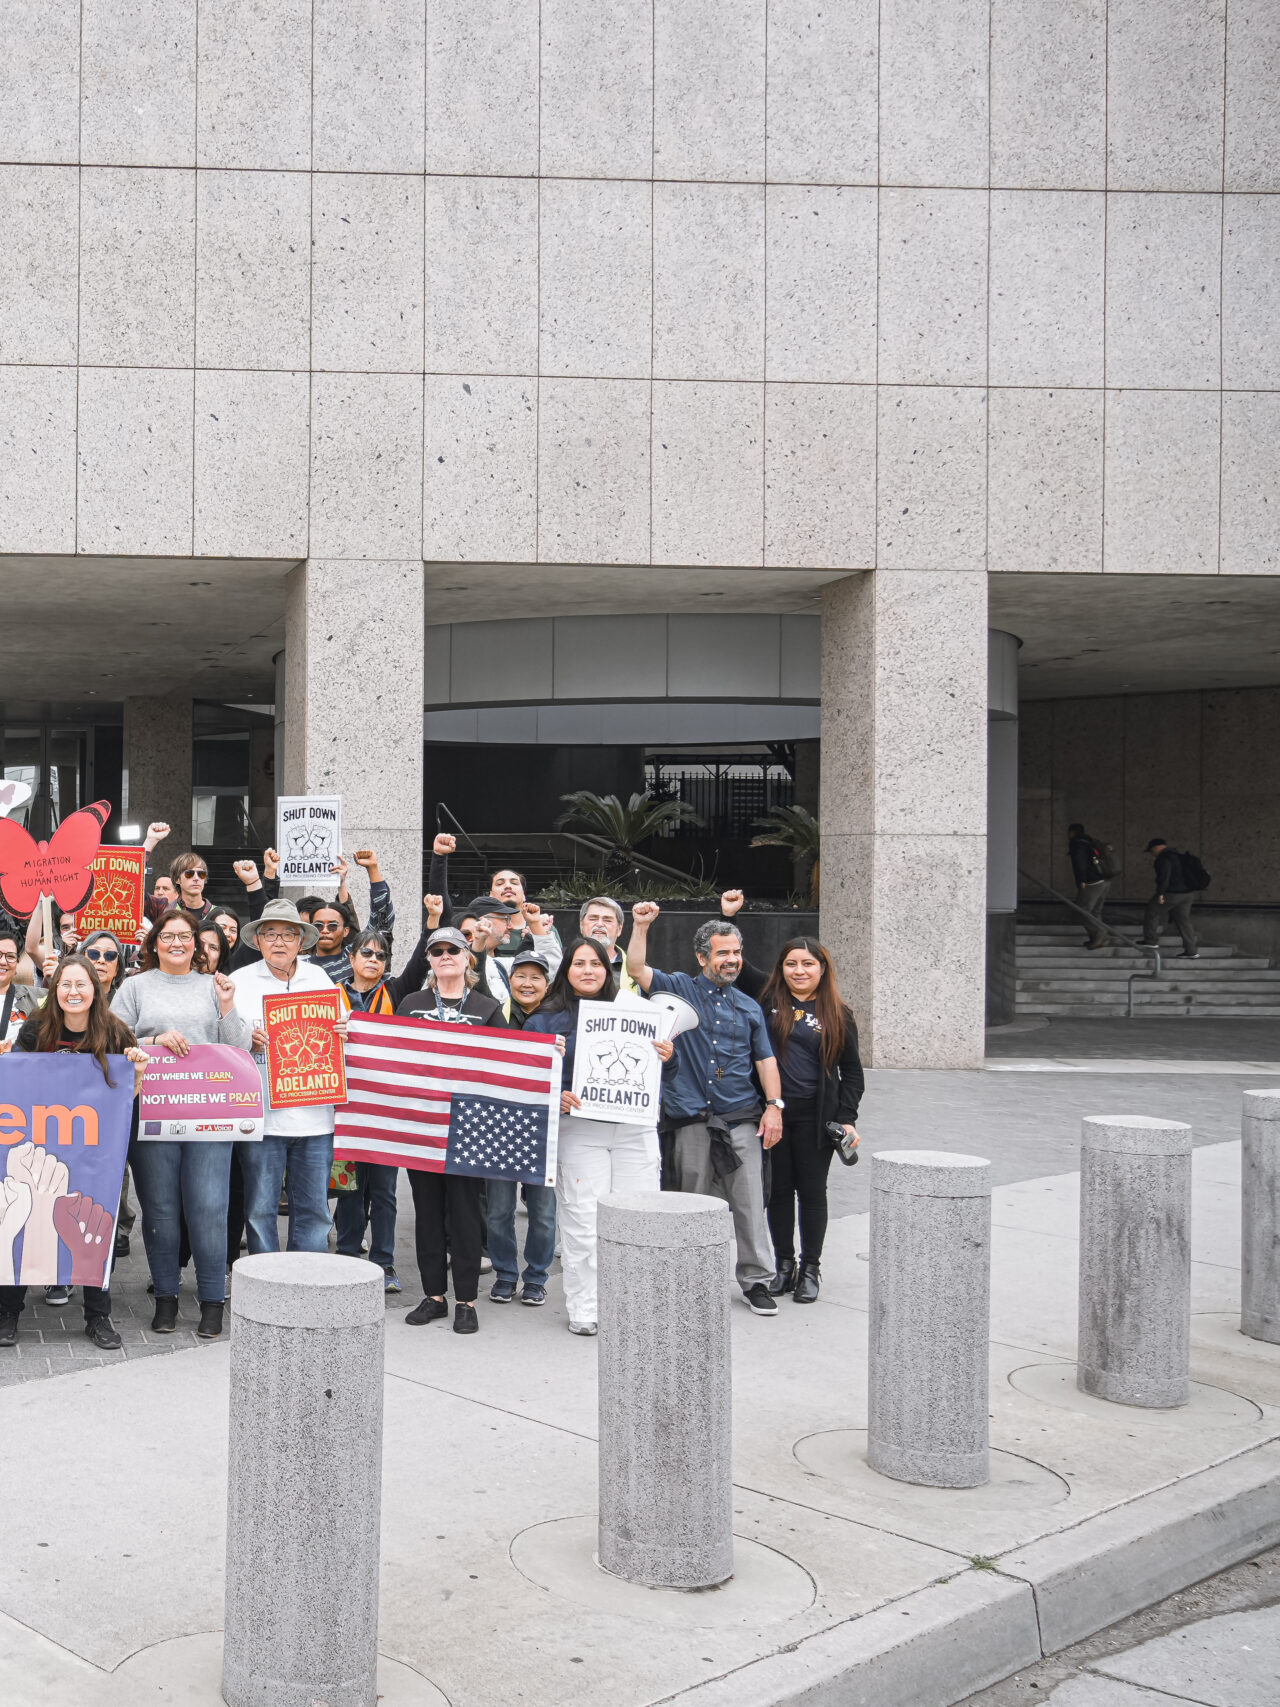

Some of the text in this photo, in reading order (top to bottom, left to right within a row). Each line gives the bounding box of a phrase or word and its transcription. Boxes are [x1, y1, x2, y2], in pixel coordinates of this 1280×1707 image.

[283, 808, 336, 822] SHUT DOWN
[24, 856, 71, 868] MIGRATION
[88, 858, 140, 875] UT DOWN
[283, 862, 334, 874] ADELANTO
[20, 873, 79, 887] HUMAN RIGHT
[80, 917, 136, 931] ADELANTO
[269, 1004, 335, 1026] SHUT DOWN
[585, 1018, 617, 1033] SHUT
[621, 1018, 656, 1039] DOWN
[162, 1072, 189, 1080] WHERE
[206, 1072, 233, 1080] LEARN,
[276, 1073, 339, 1092] ADELANTO
[142, 1092, 260, 1104] NOT WHERE WE PRAY!
[580, 1086, 650, 1107] ADELANTO
